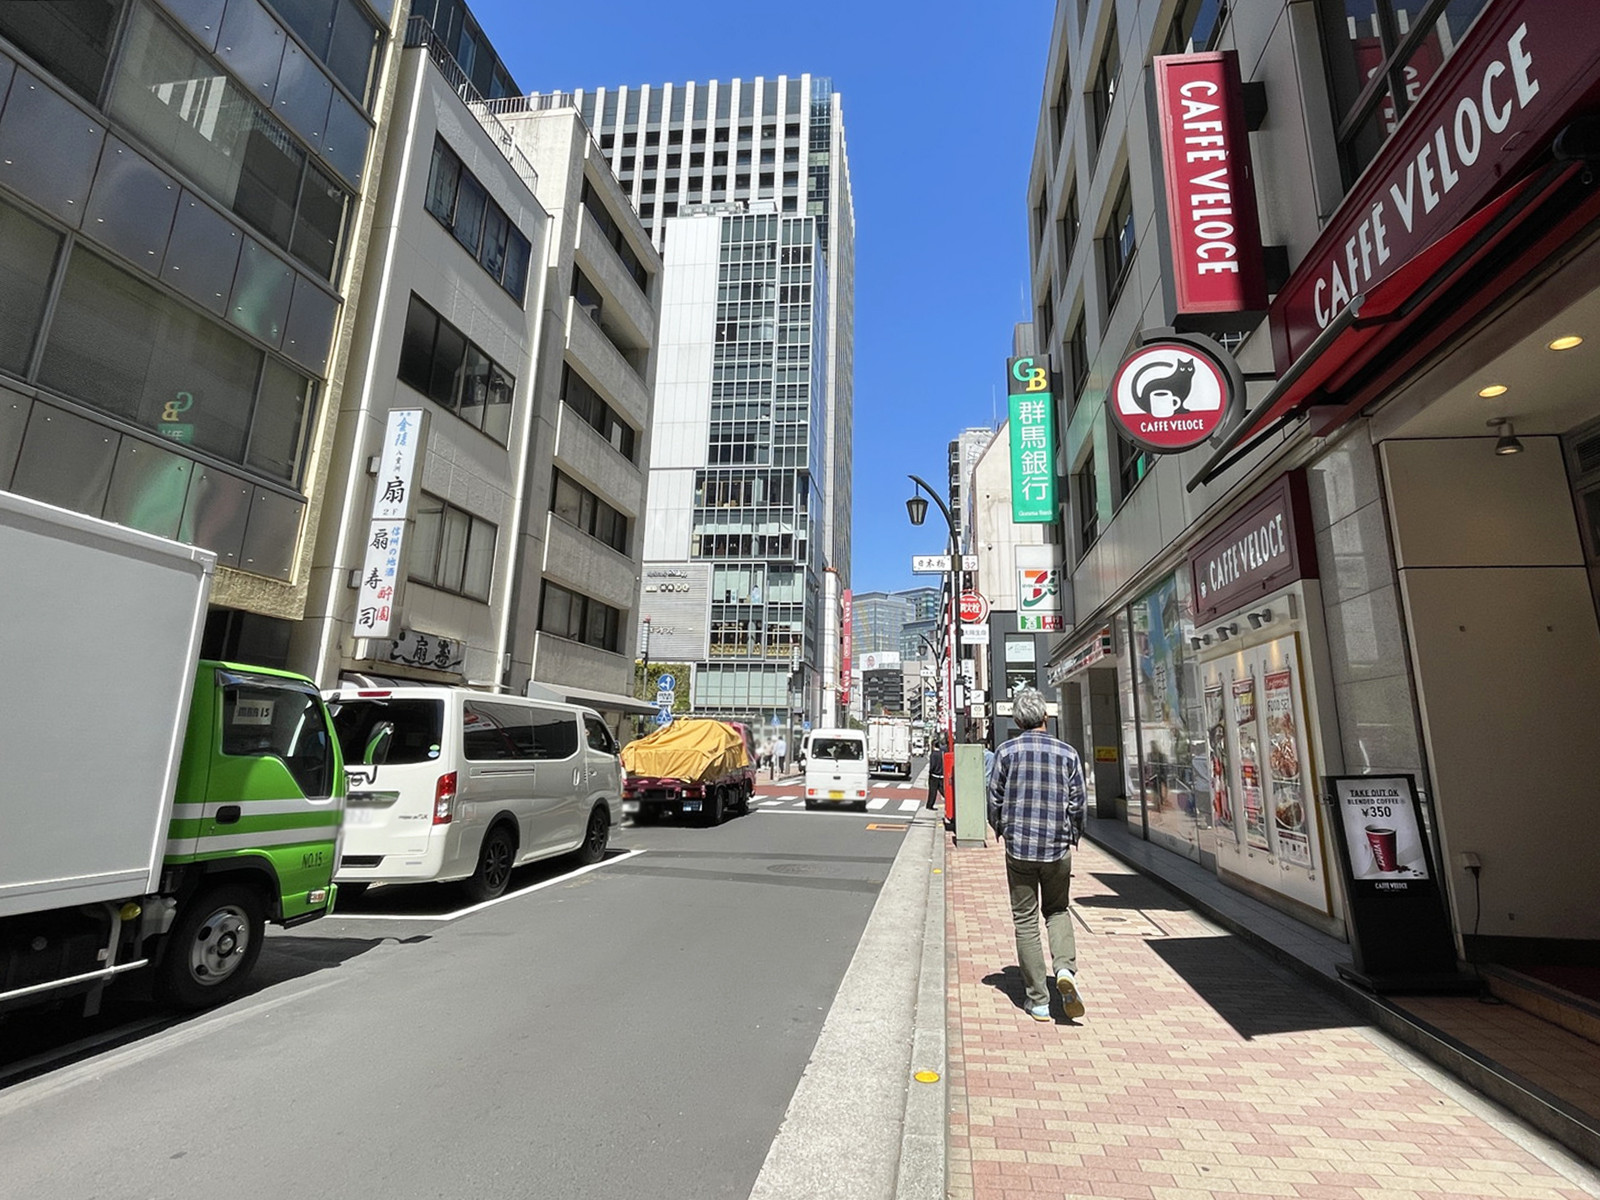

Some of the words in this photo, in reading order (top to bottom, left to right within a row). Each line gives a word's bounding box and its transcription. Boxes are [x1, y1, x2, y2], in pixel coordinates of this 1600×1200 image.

[1389, 21, 1540, 234] VELOCE
[1189, 168, 1239, 275] VELOCE
[1013, 358, 1047, 392] GB
[1170, 419, 1204, 431] VELOCE
[1019, 400, 1049, 501] 群馬銀行
[379, 476, 405, 504] 扇
[1238, 513, 1285, 573] VELOCE
[1350, 789, 1370, 797] TAKE
[1371, 789, 1386, 797] OUT
[1388, 789, 1400, 797] OK
[1361, 806, 1392, 818] ¥350
